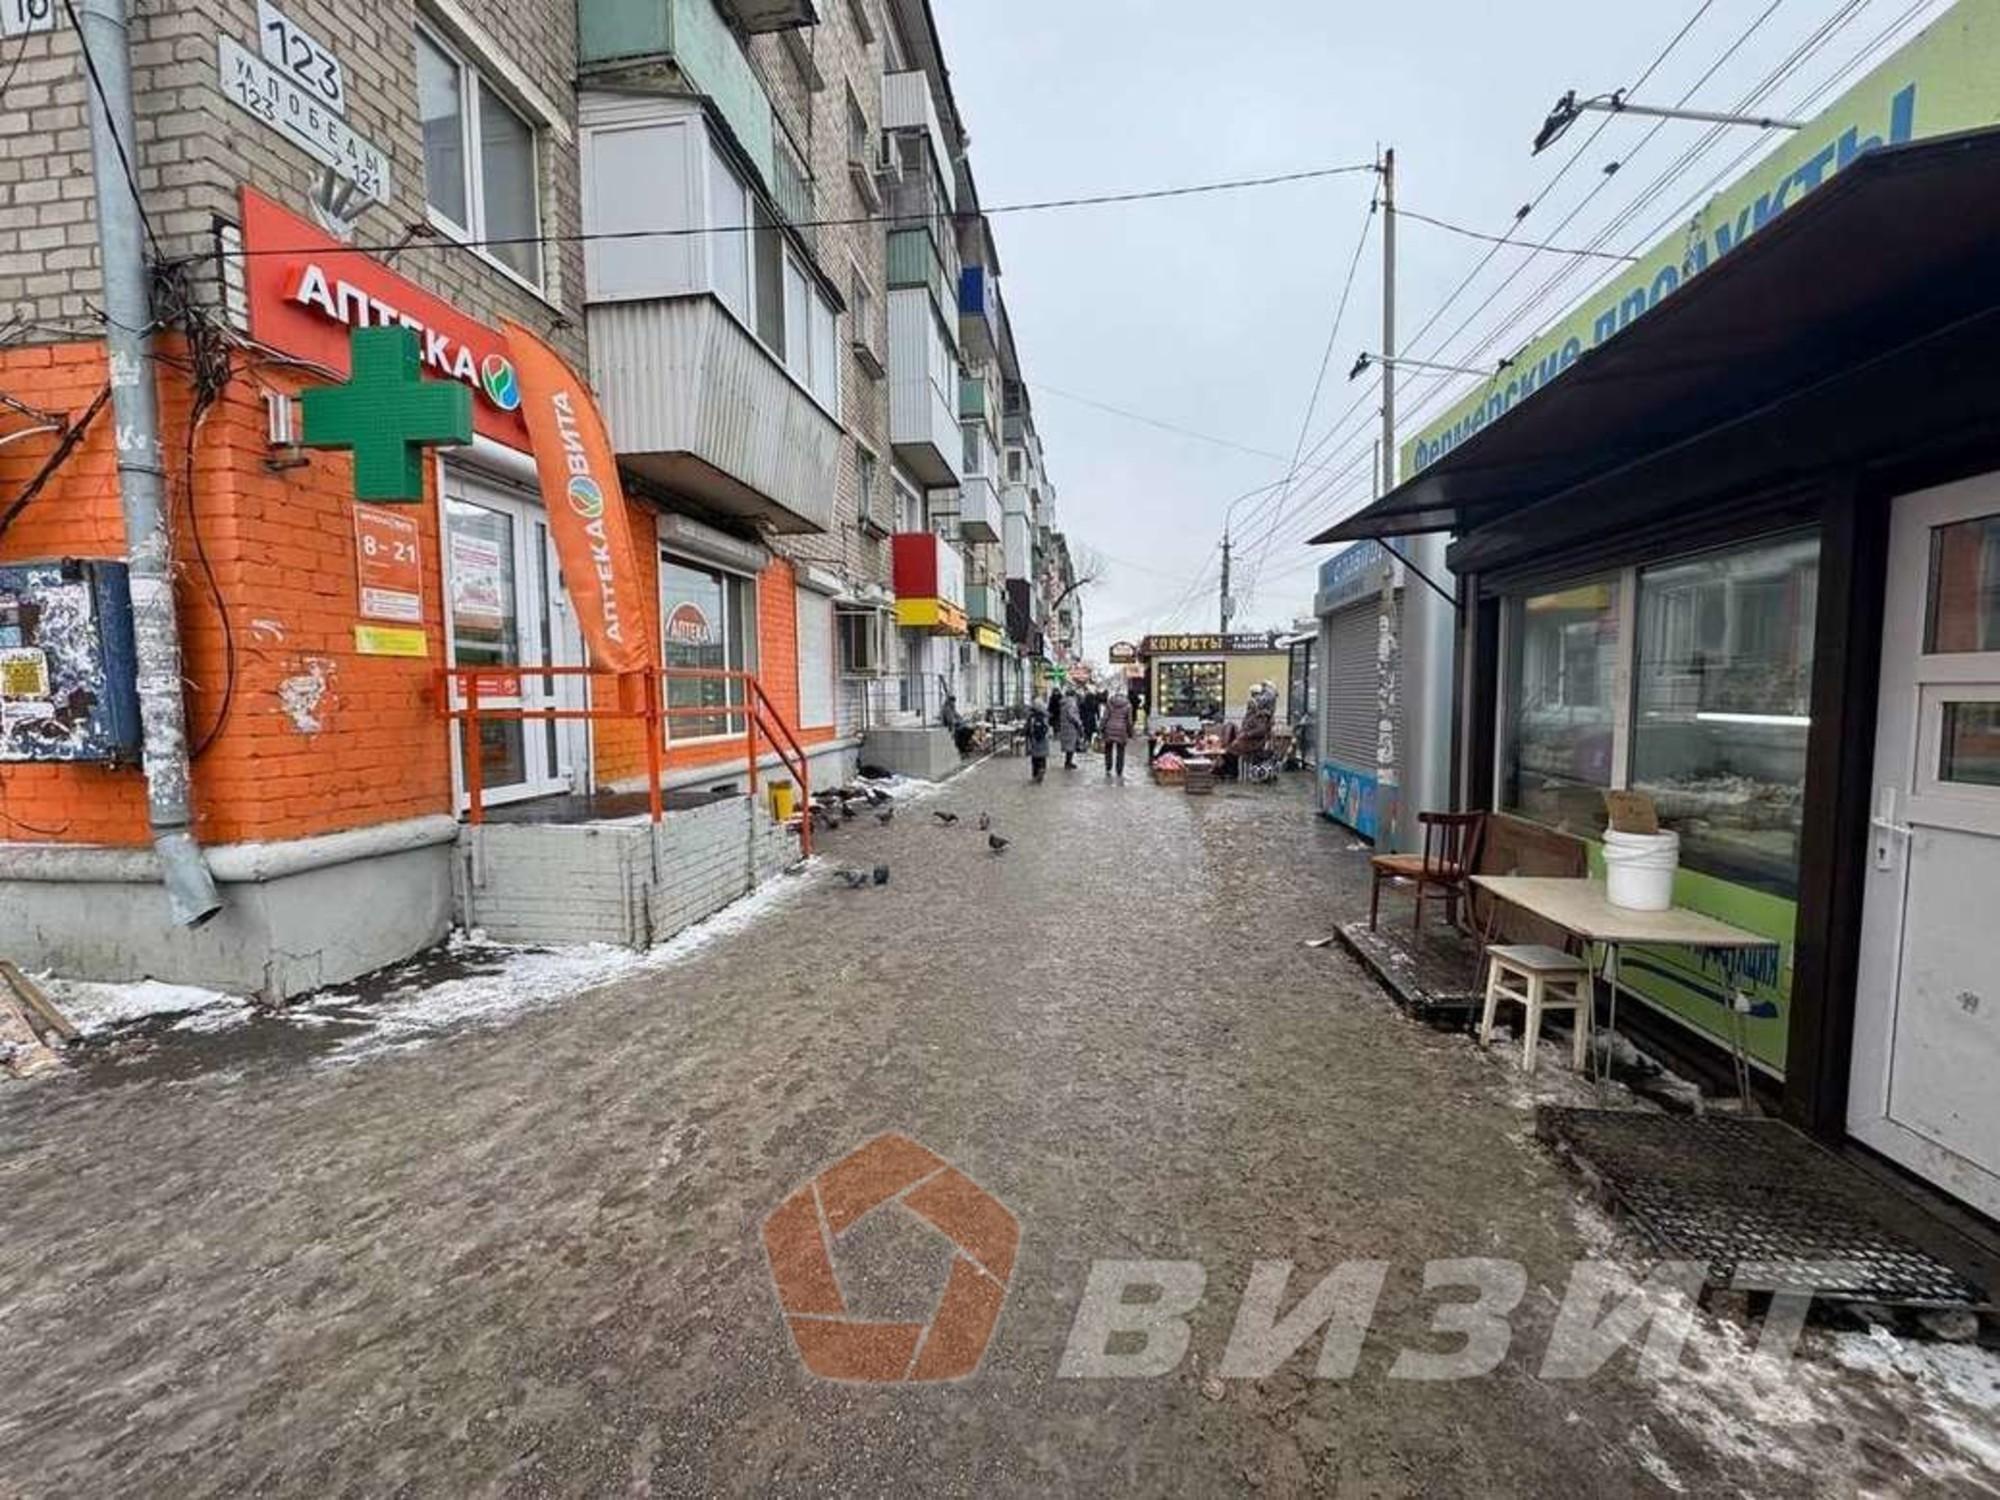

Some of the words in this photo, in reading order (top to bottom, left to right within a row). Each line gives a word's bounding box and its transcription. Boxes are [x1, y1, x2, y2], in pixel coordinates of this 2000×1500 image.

[268, 21, 339, 100] 123
[237, 83, 276, 121] 123
[352, 165, 381, 196] 121
[268, 77, 379, 173] ПОБЕДЫ
[553, 391, 590, 475] ВИТА
[585, 518, 623, 644] АПТЕКА
[671, 619, 708, 640] АПТЕКА
[1151, 636, 1223, 650] КОНФЕТЫ
